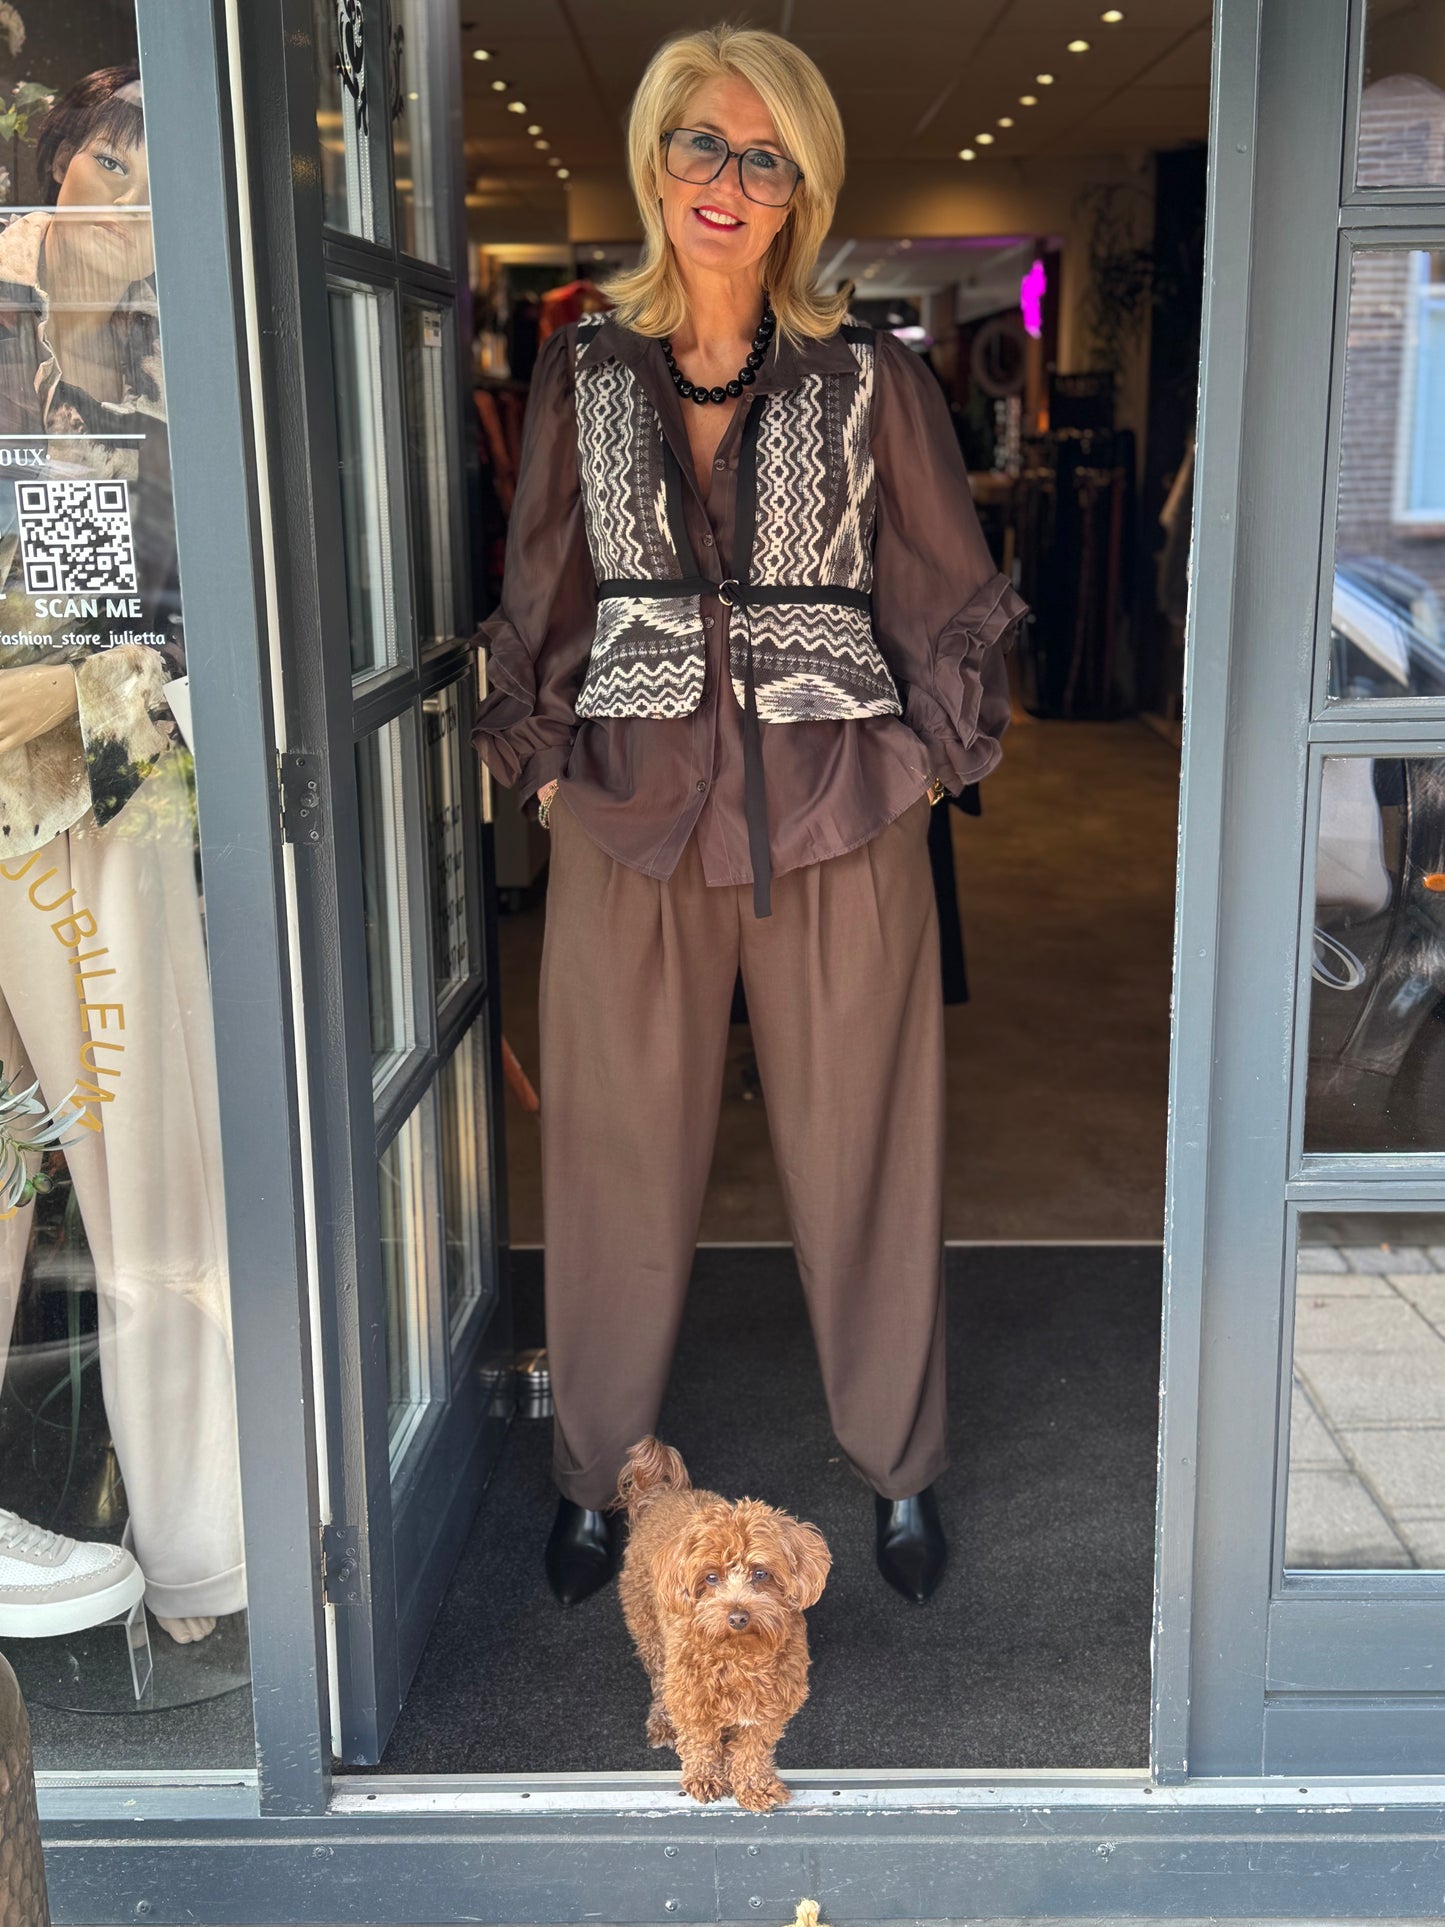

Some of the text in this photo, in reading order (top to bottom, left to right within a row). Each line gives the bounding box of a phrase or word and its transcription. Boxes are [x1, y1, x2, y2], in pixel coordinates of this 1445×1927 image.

[34, 598, 143, 618] SCAN ME
[0, 630, 165, 648] ashion_store_julietta
